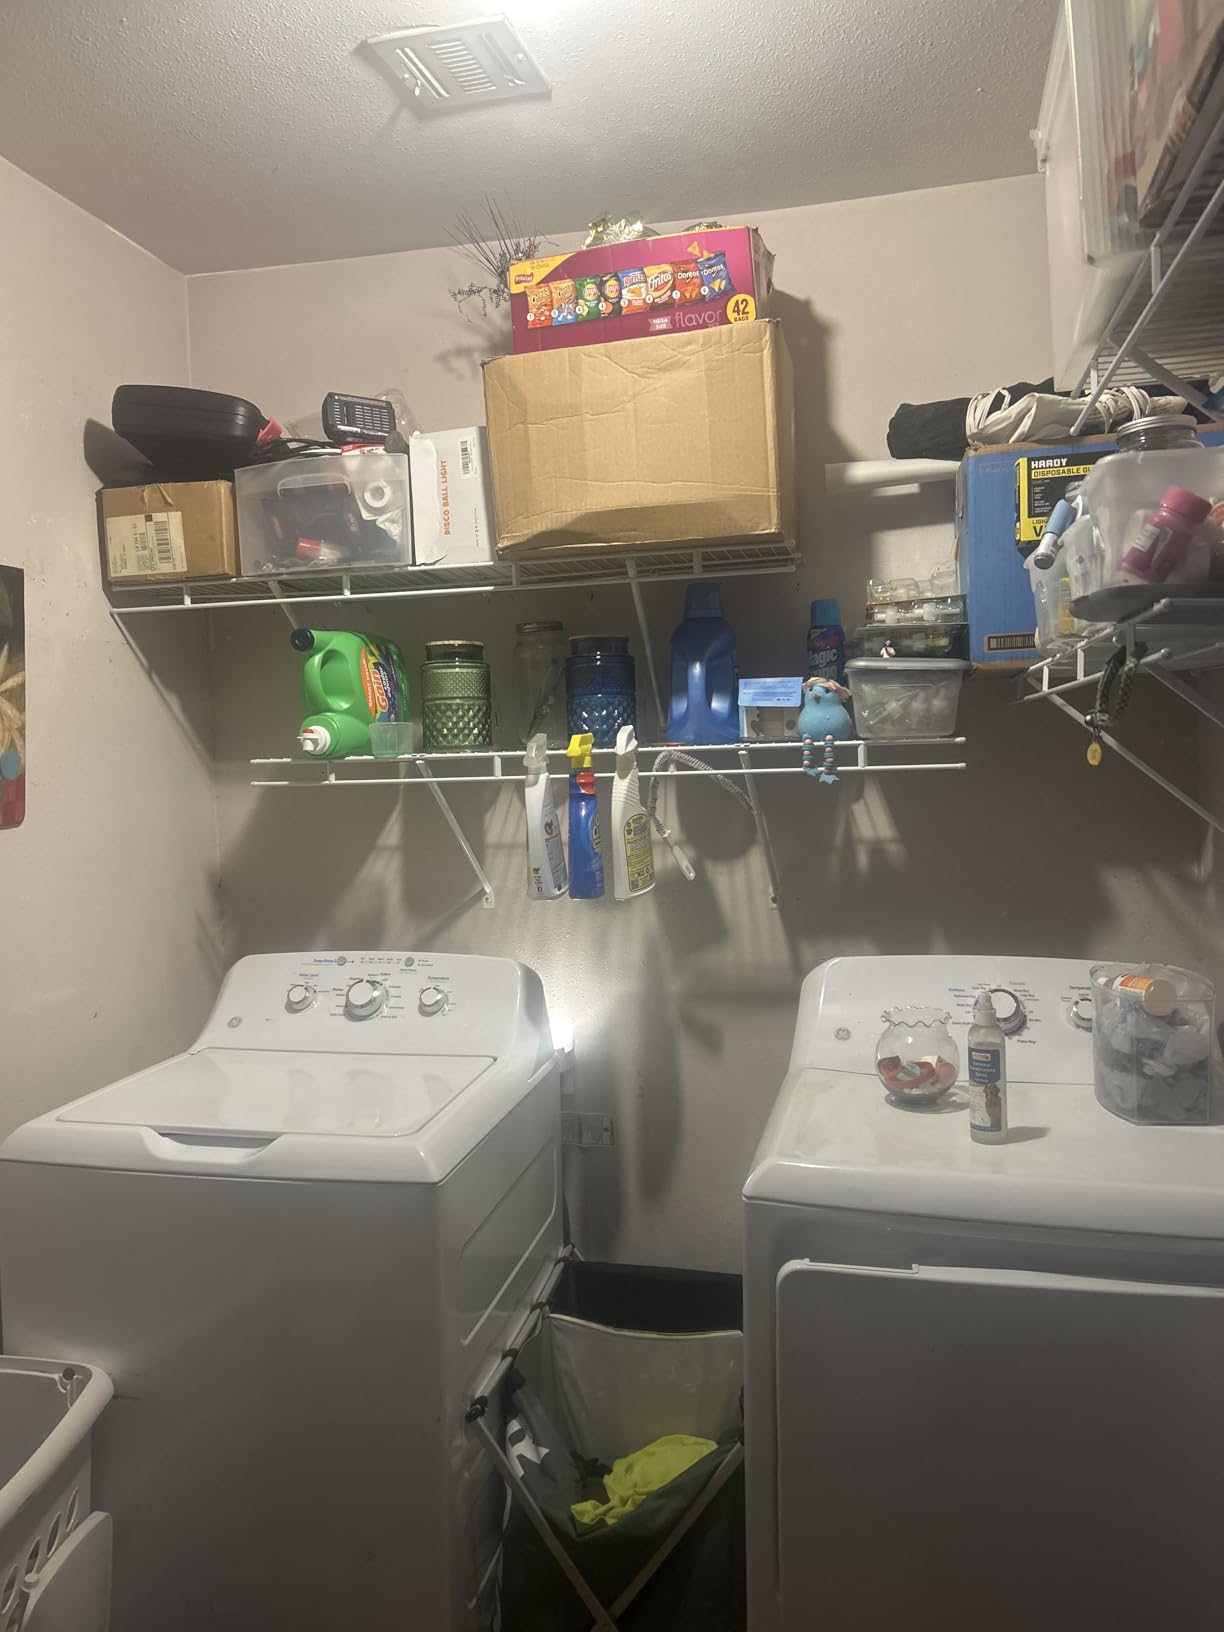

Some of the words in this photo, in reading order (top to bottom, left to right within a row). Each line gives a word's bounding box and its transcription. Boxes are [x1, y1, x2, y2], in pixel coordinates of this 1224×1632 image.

[677, 270, 700, 280] Doritos
[703, 264, 724, 276] Doritos
[650, 271, 672, 291] Fritos
[732, 298, 749, 316] 42
[675, 309, 722, 329] flavor
[733, 315, 749, 323] BAGS
[440, 460, 448, 484] LIGHT
[1031, 458, 1067, 469] HARDY
[1033, 467, 1081, 477] DISPOSABLE
[441, 486, 449, 507] BALL
[443, 509, 451, 535] DISCO
[371, 668, 389, 712] Gain
